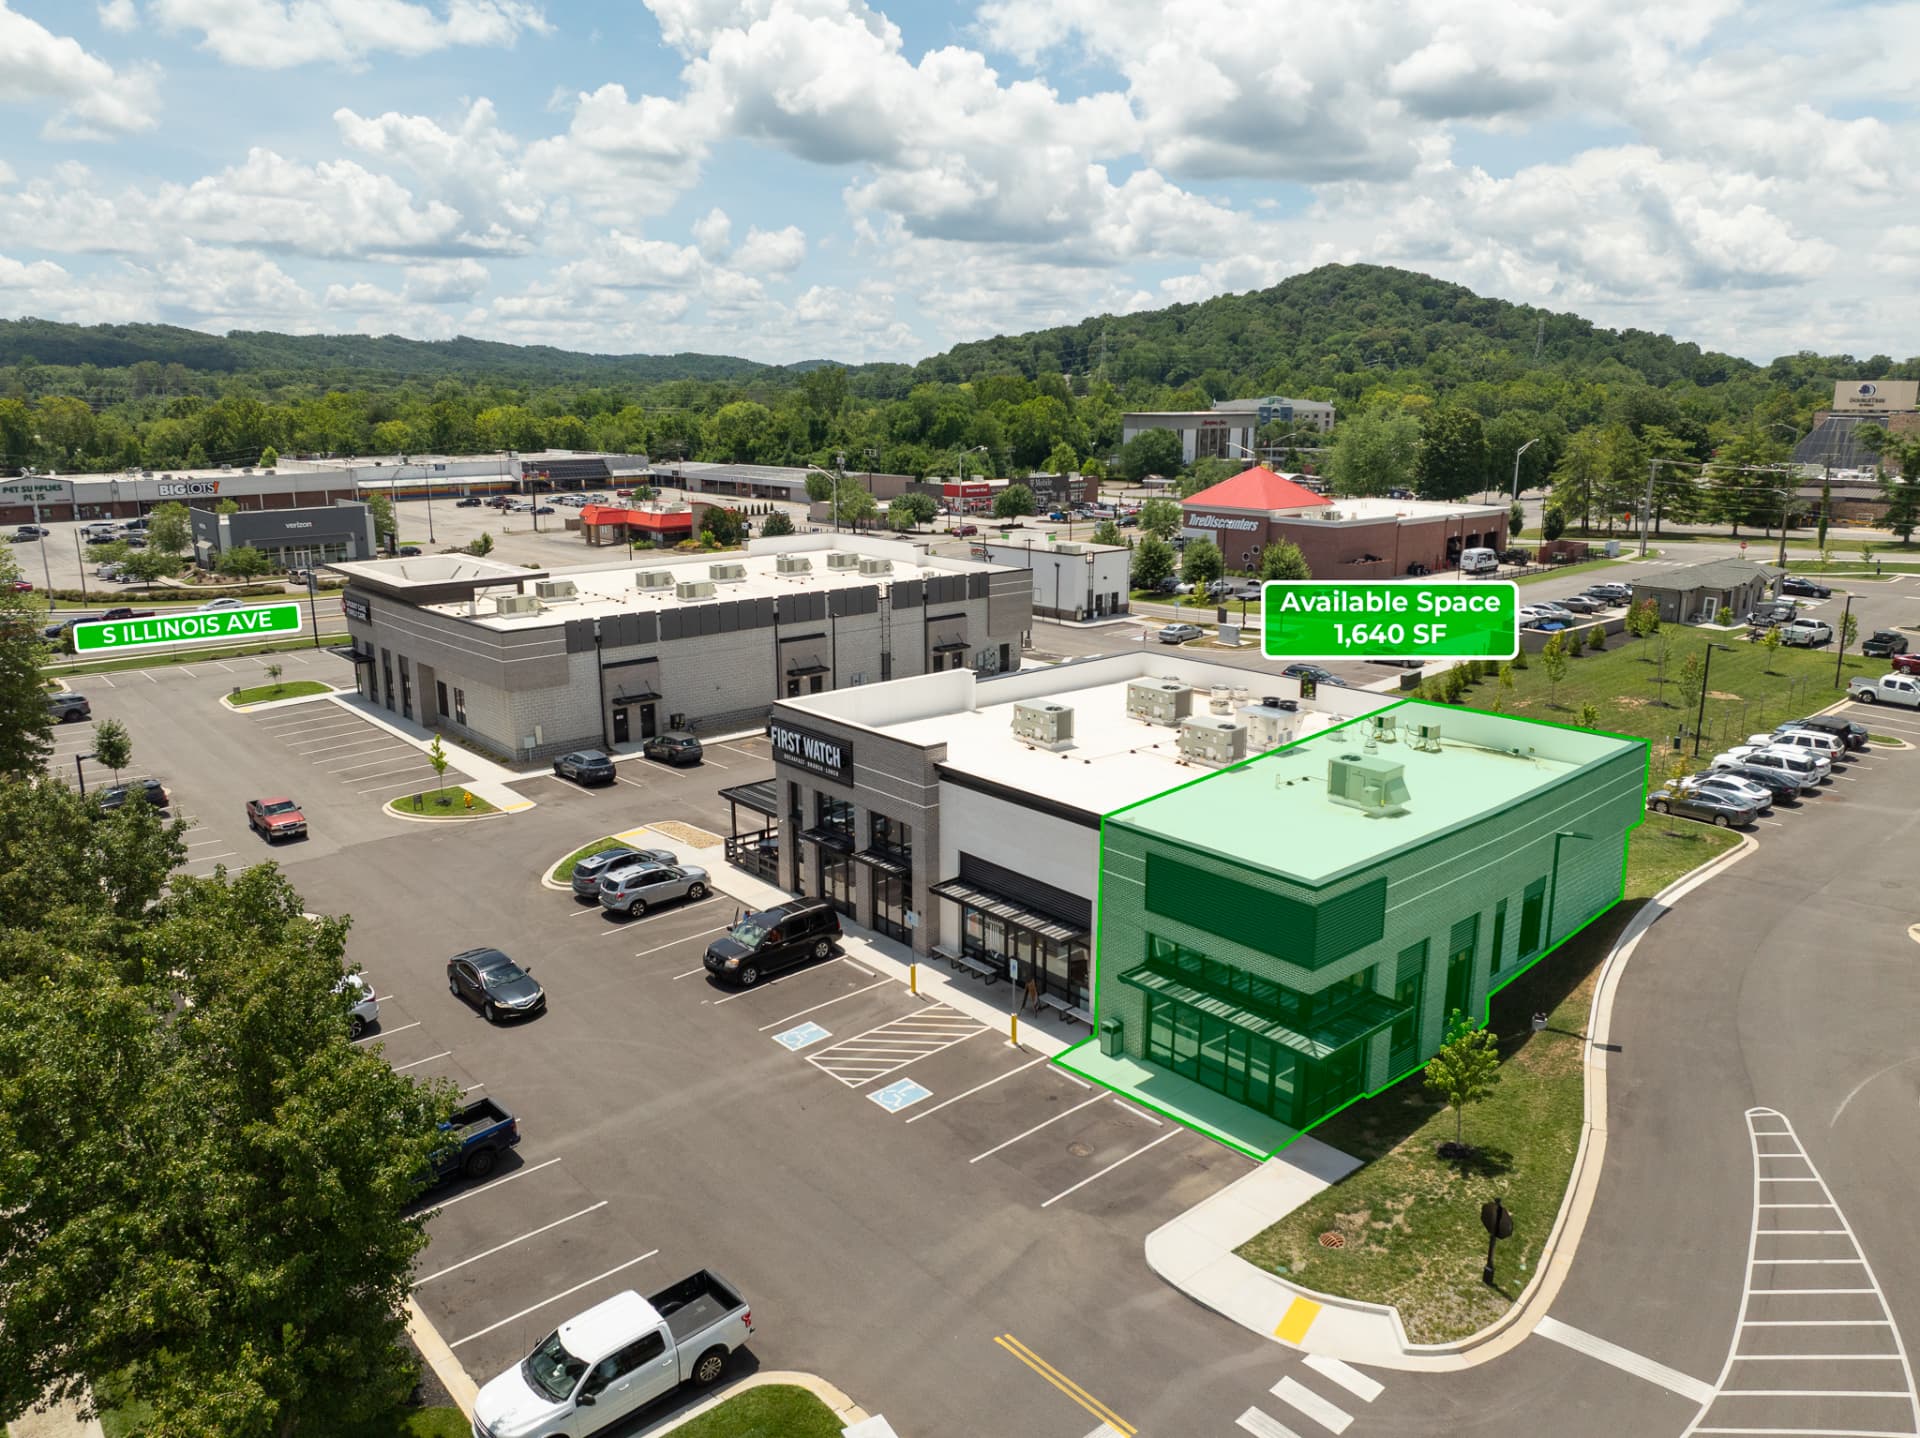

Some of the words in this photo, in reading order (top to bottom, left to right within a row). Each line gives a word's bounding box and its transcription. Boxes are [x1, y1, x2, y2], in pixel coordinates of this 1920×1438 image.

[21, 484, 63, 492] SUPPLIES
[159, 484, 186, 496] BIG
[285, 521, 313, 529] verizon
[771, 726, 801, 755] FIRST
[803, 736, 841, 769] WATCH
